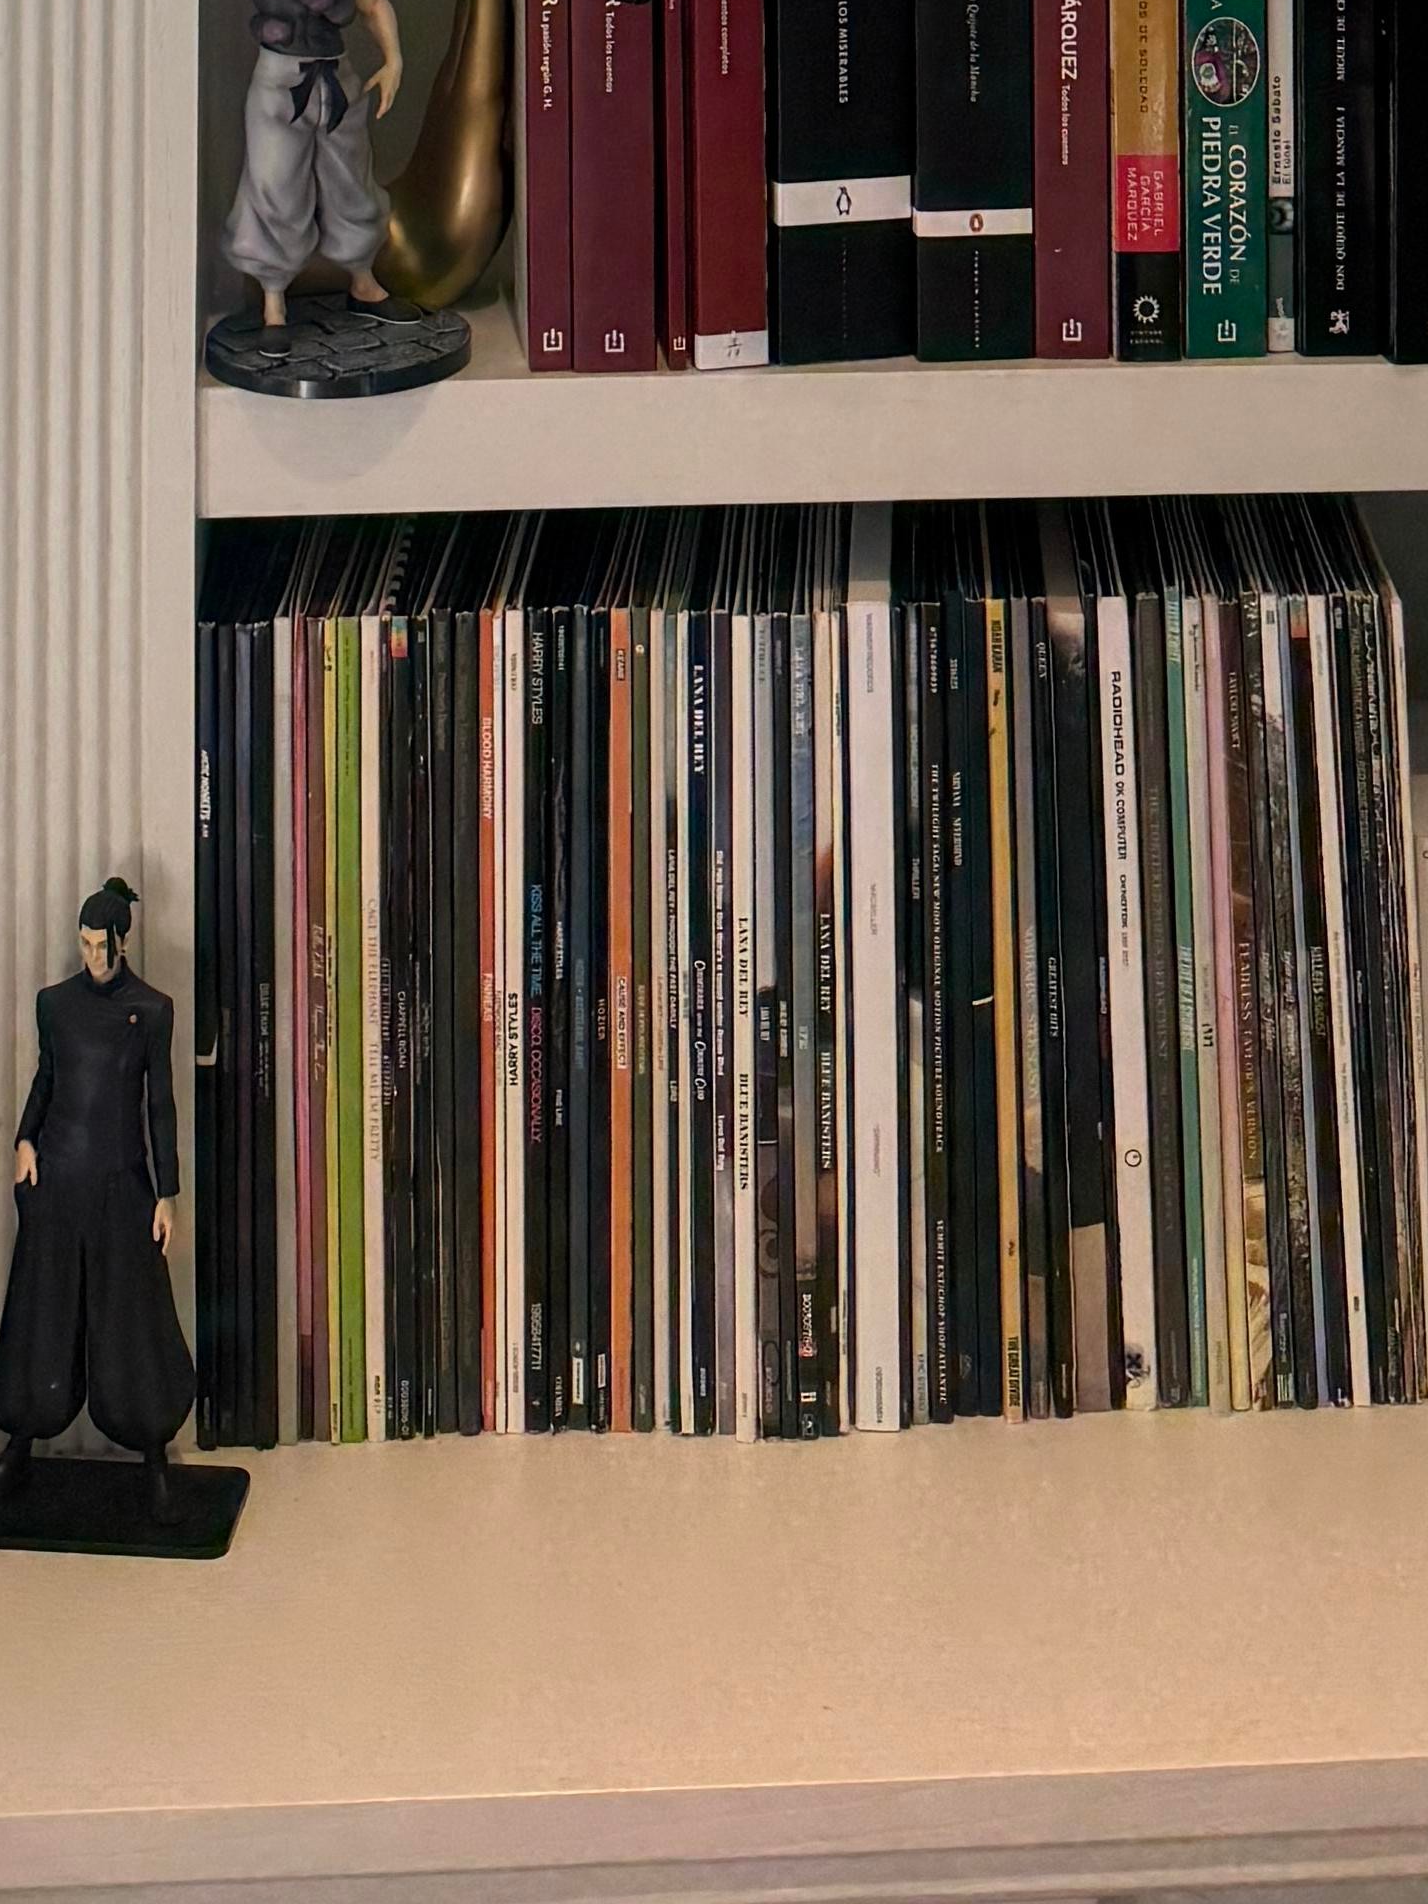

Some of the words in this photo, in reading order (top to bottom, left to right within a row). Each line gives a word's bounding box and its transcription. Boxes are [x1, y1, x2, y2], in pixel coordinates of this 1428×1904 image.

[1201, 117, 1221, 207] PIEDRA
[1228, 144, 1249, 261] CORAZÓN
[1202, 214, 1221, 295] VERDE
[532, 632, 543, 676] HARRY
[532, 679, 543, 724] STYLES
[1110, 671, 1124, 776] RADIOHEAD
[738, 917, 749, 955] LANA
[738, 959, 750, 986] DEL
[739, 991, 750, 1017] REY
[739, 1073, 751, 1106] BLUE
[739, 1110, 751, 1190] BANISTERS
